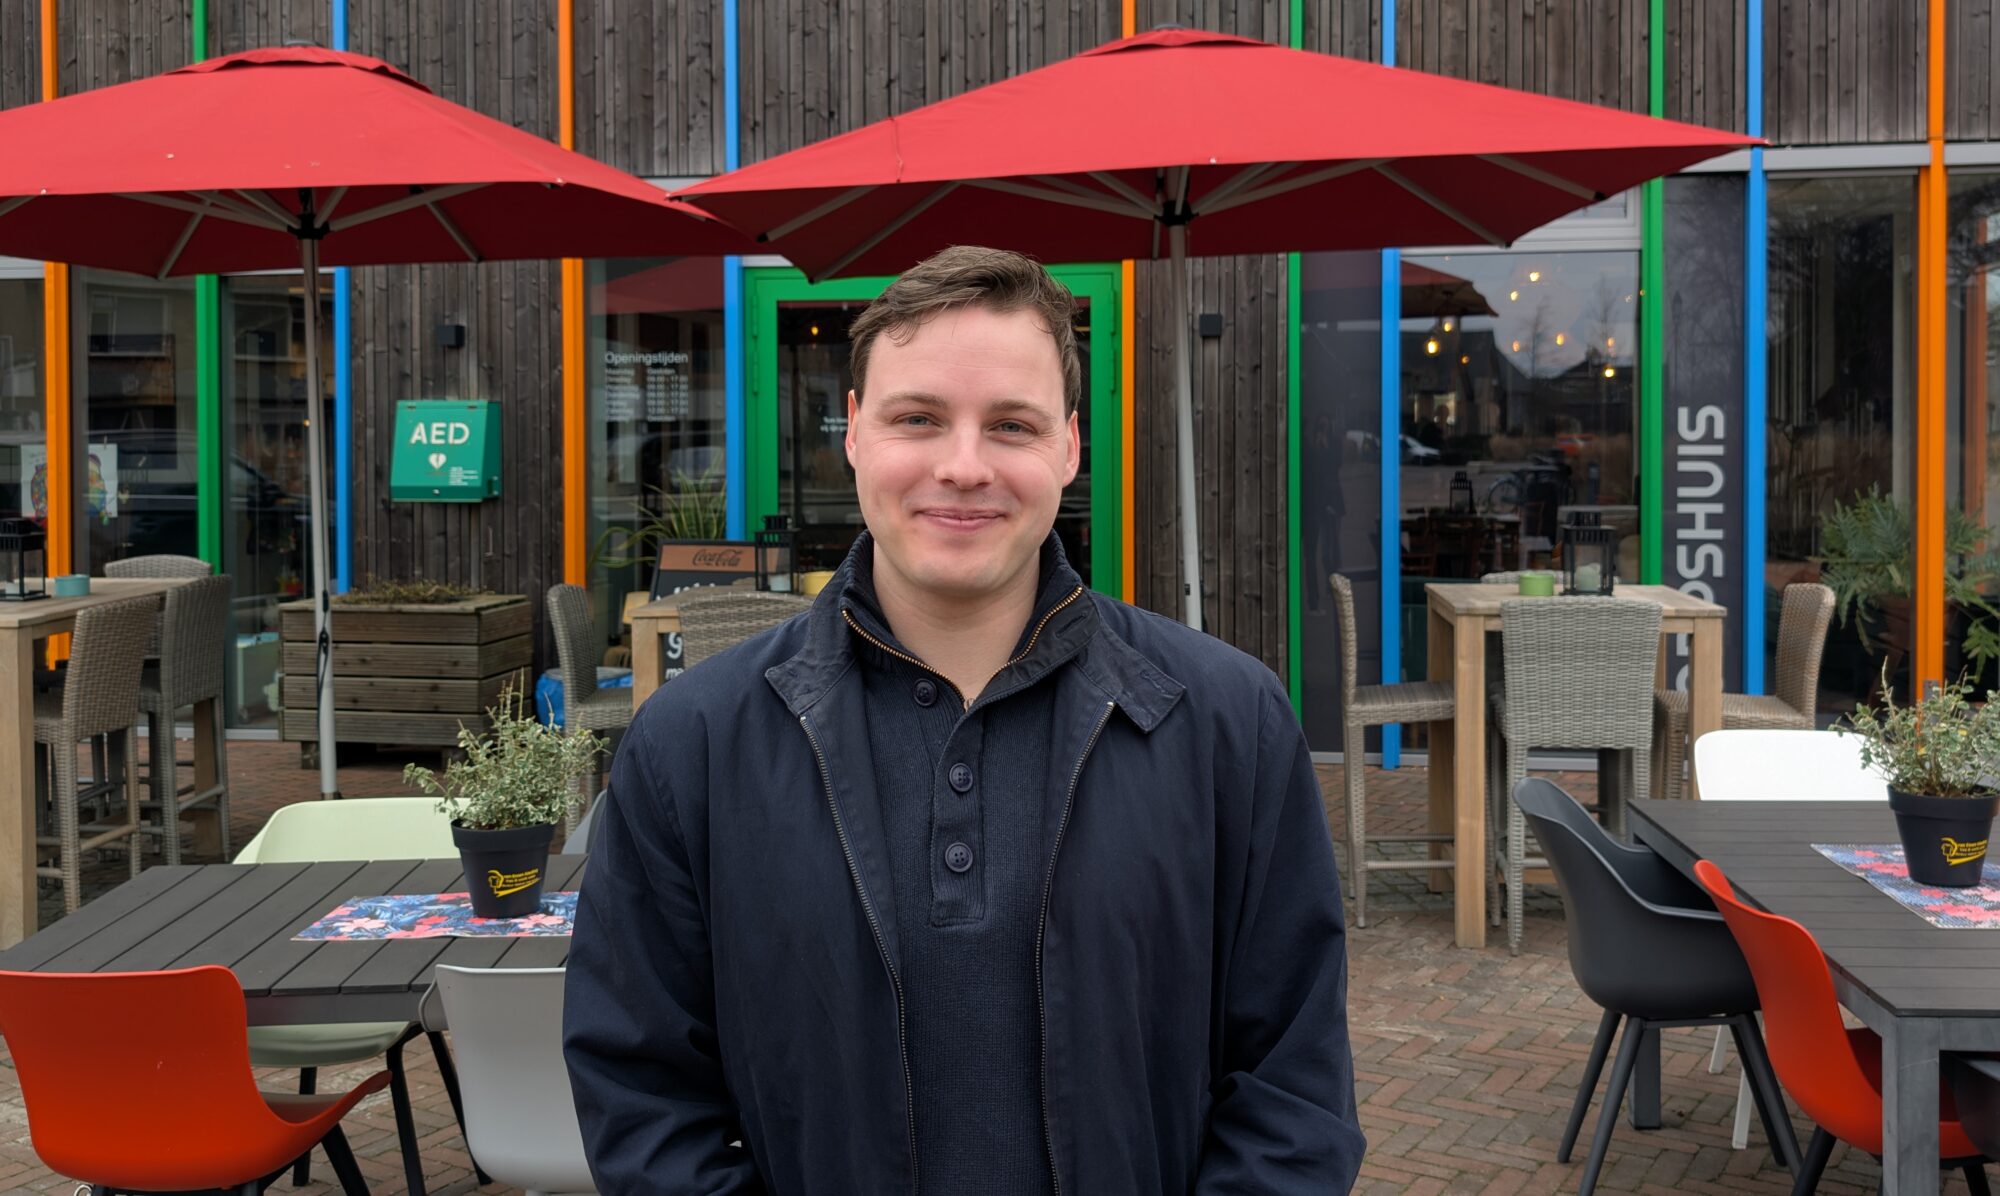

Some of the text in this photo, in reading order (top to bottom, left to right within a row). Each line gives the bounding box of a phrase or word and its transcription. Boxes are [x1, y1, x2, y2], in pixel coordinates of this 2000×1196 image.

[605, 352, 688, 366] Openingstijden
[410, 422, 470, 444] AED
[1676, 405, 1724, 692] SHUIS
